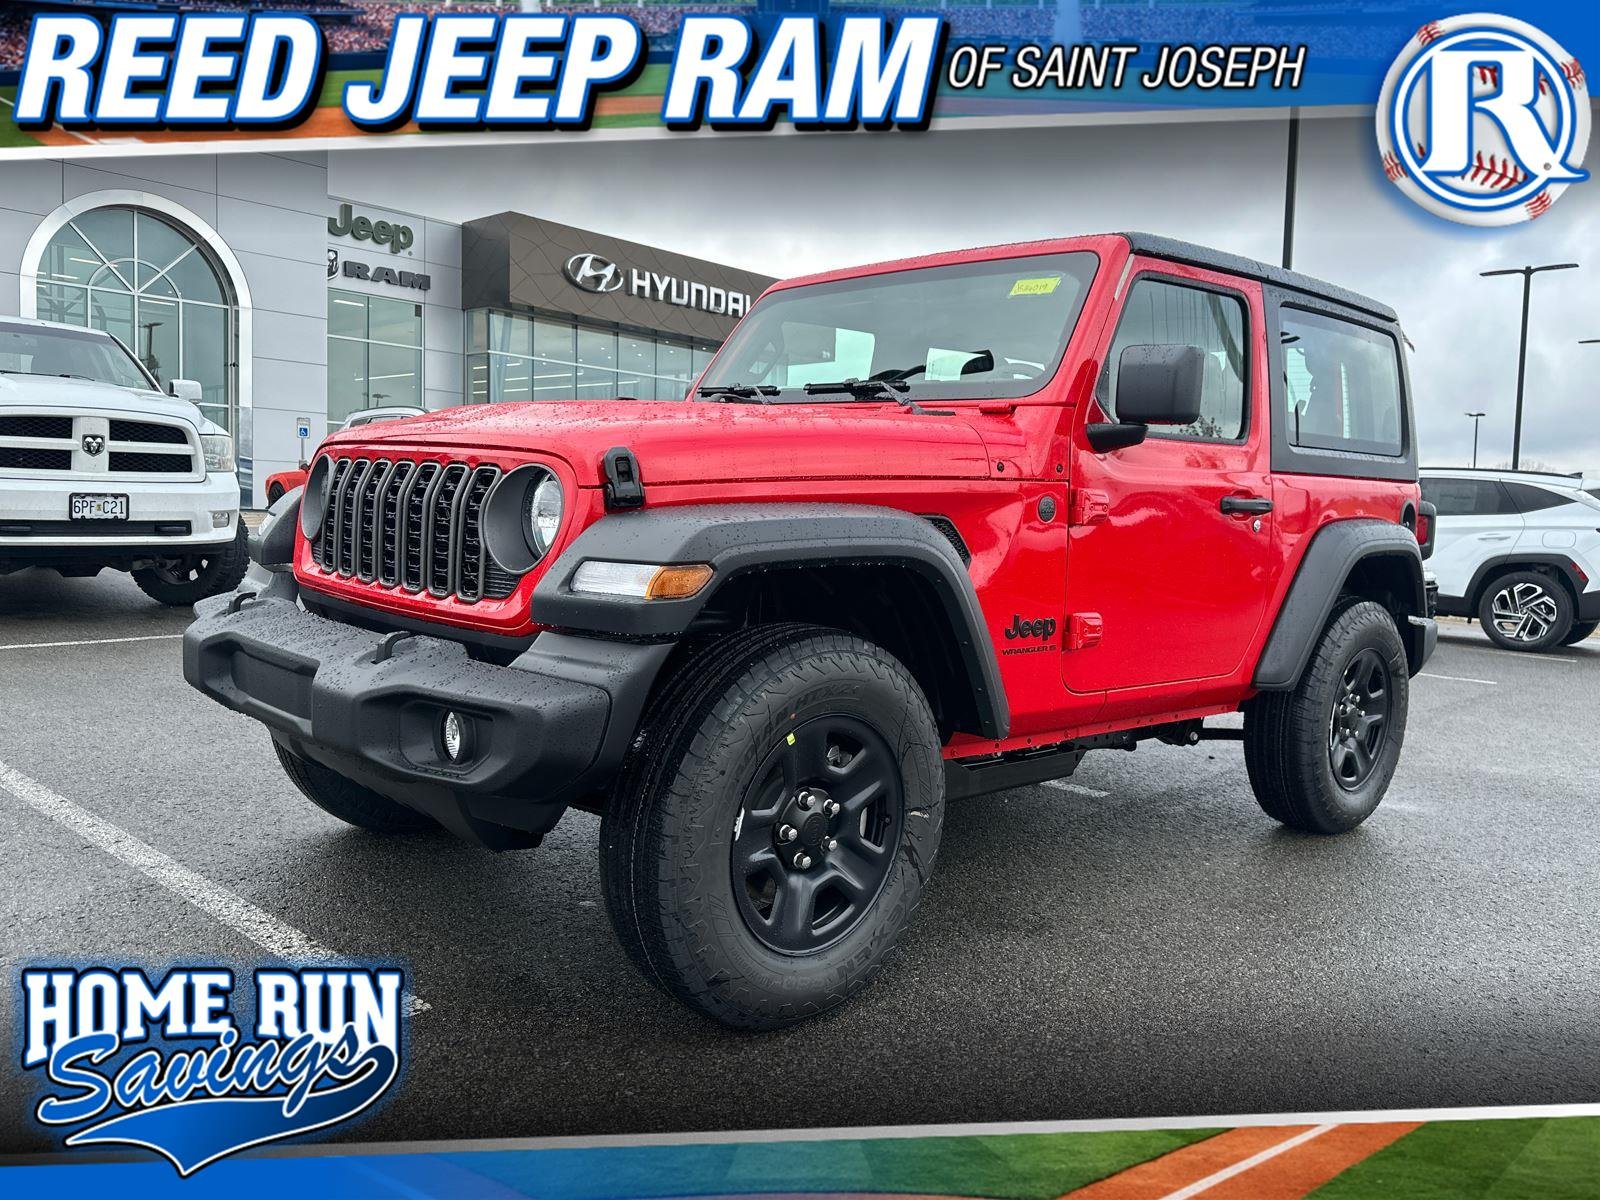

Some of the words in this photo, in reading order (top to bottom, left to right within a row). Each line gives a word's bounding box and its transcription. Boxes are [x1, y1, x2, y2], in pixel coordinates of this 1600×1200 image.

[327, 203, 414, 254] Jeep
[343, 260, 431, 291] RAM
[73, 500, 97, 514] 6PF
[102, 500, 124, 514] C21
[1005, 614, 1056, 641] Jeep
[1001, 645, 1048, 656] WRANGLER
